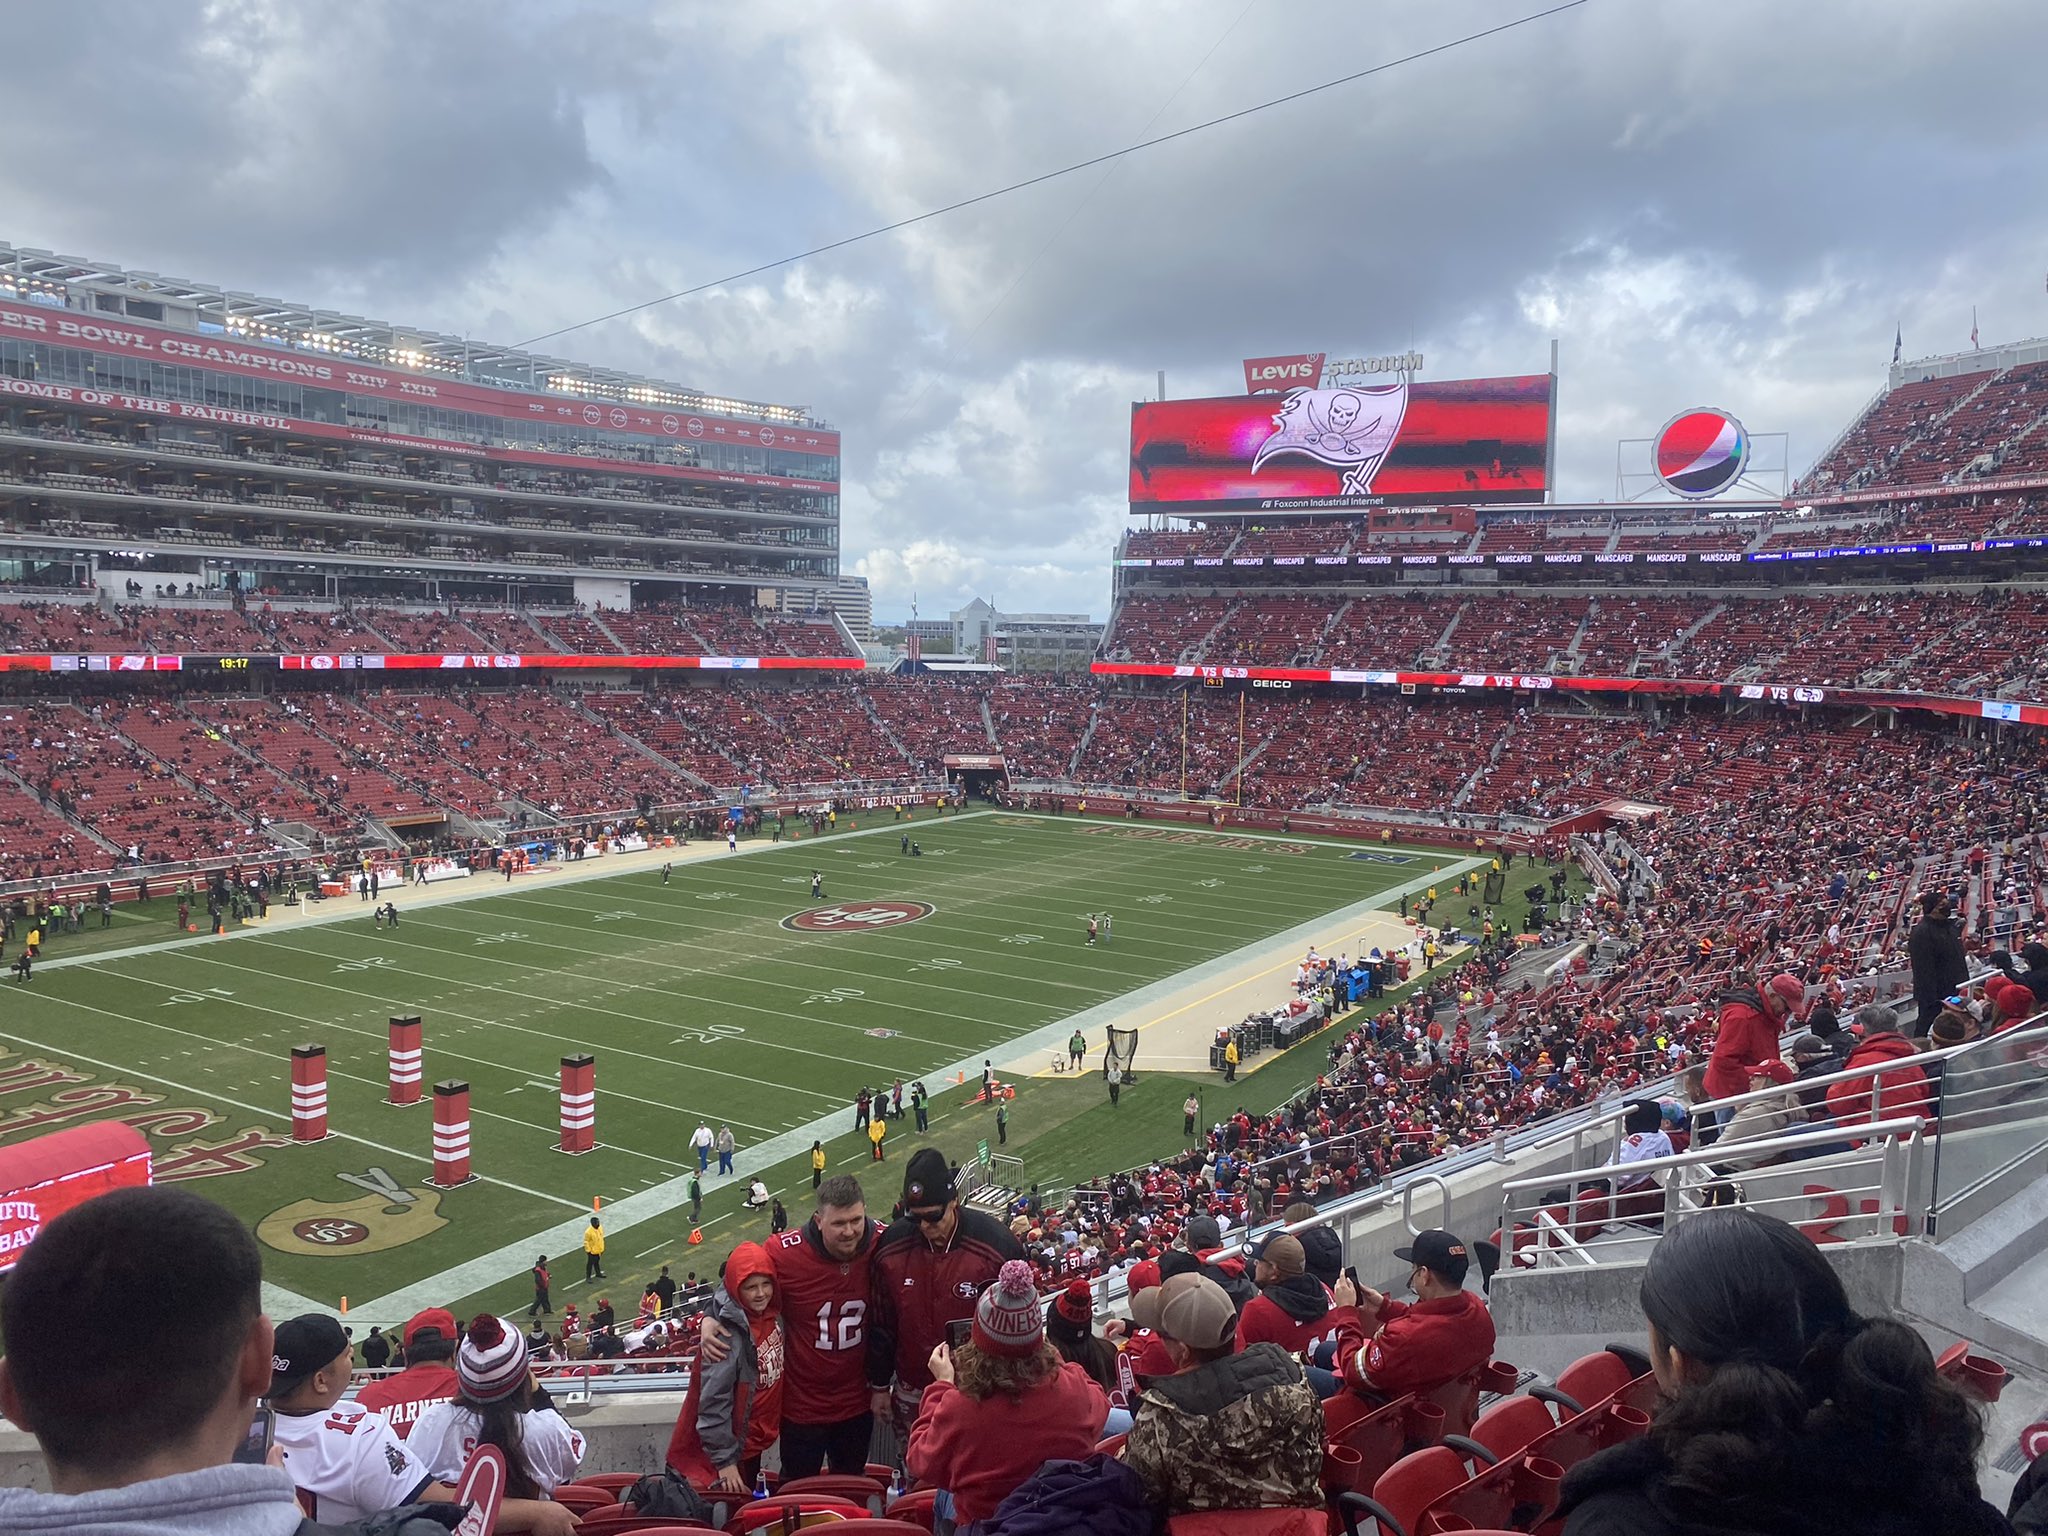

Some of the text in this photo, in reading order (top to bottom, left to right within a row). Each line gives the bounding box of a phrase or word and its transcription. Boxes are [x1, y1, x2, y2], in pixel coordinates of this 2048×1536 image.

[57, 320, 153, 351] BOWL
[160, 339, 332, 380] CHAMPIONS
[346, 371, 388, 389] XXIV
[400, 381, 437, 398] XXIX
[1329, 353, 1423, 377] STADIUM
[0, 380, 291, 429] HOME OF THE FAITHFUL
[350, 433, 487, 456] 7-TIME CONFERENCE CHAMPIONS
[1274, 499, 1309, 508] Foxconn
[1310, 498, 1350, 507] Industrial
[1350, 496, 1384, 506] Internet
[1156, 559, 1185, 567] MANSCAPED
[1193, 558, 1223, 566] MANSCAPED
[1233, 558, 1264, 566] MANSCAPED
[1273, 557, 1305, 566] MANSCAPED
[1315, 556, 1348, 565] MANSCAPED
[1358, 556, 1392, 564] MANSCAPED
[1402, 555, 1437, 564] MANSCAPED
[1448, 555, 1484, 563] MANSCAPED
[1495, 554, 1533, 563] MANSCAPED
[1544, 554, 1582, 563] MANSCAPED
[1594, 554, 1634, 563] MANSCAPED
[1646, 553, 1687, 562] MANSCAPED
[1700, 553, 1741, 562] MANSCAPED
[219, 658, 249, 669] 19:17
[471, 656, 489, 668] VS
[1201, 666, 1217, 677] VS
[1252, 679, 1292, 689] GEICO
[1494, 675, 1513, 687] VS
[1770, 686, 1789, 700] VS
[0, 1223, 40, 1254] BAY
[781, 1230, 803, 1249] 12
[1069, 1257, 1081, 1270] 97
[815, 1300, 868, 1351] 12
[987, 1309, 1042, 1335] NINERS
